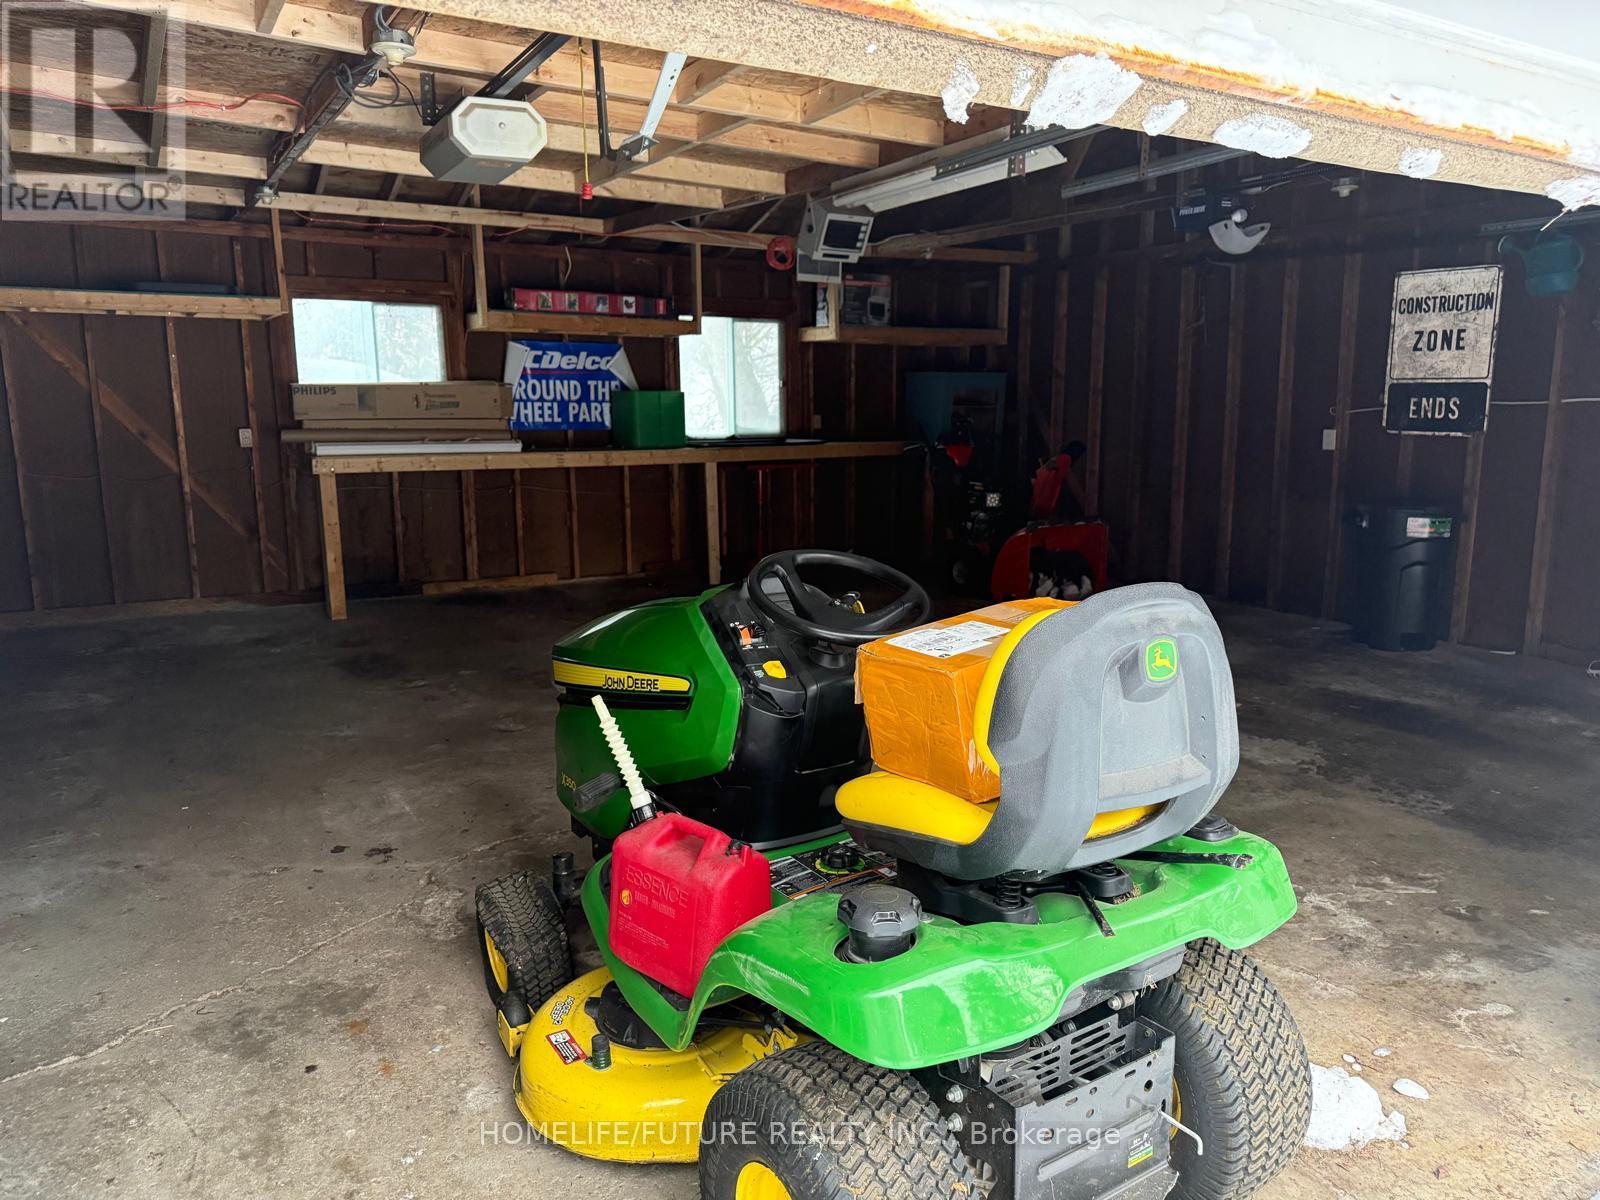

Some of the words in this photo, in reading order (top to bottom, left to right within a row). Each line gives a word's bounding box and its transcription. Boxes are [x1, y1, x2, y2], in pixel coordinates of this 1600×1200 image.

[1398, 292, 1495, 315] CONSTRUCTION
[1412, 328, 1467, 352] ZONE
[292, 386, 337, 397] PHILIPS
[513, 401, 562, 423] HEEL
[1408, 396, 1461, 420] ENDS
[602, 674, 625, 690] JOHN
[626, 675, 660, 691] DEERE
[626, 865, 689, 909] ESSENCE
